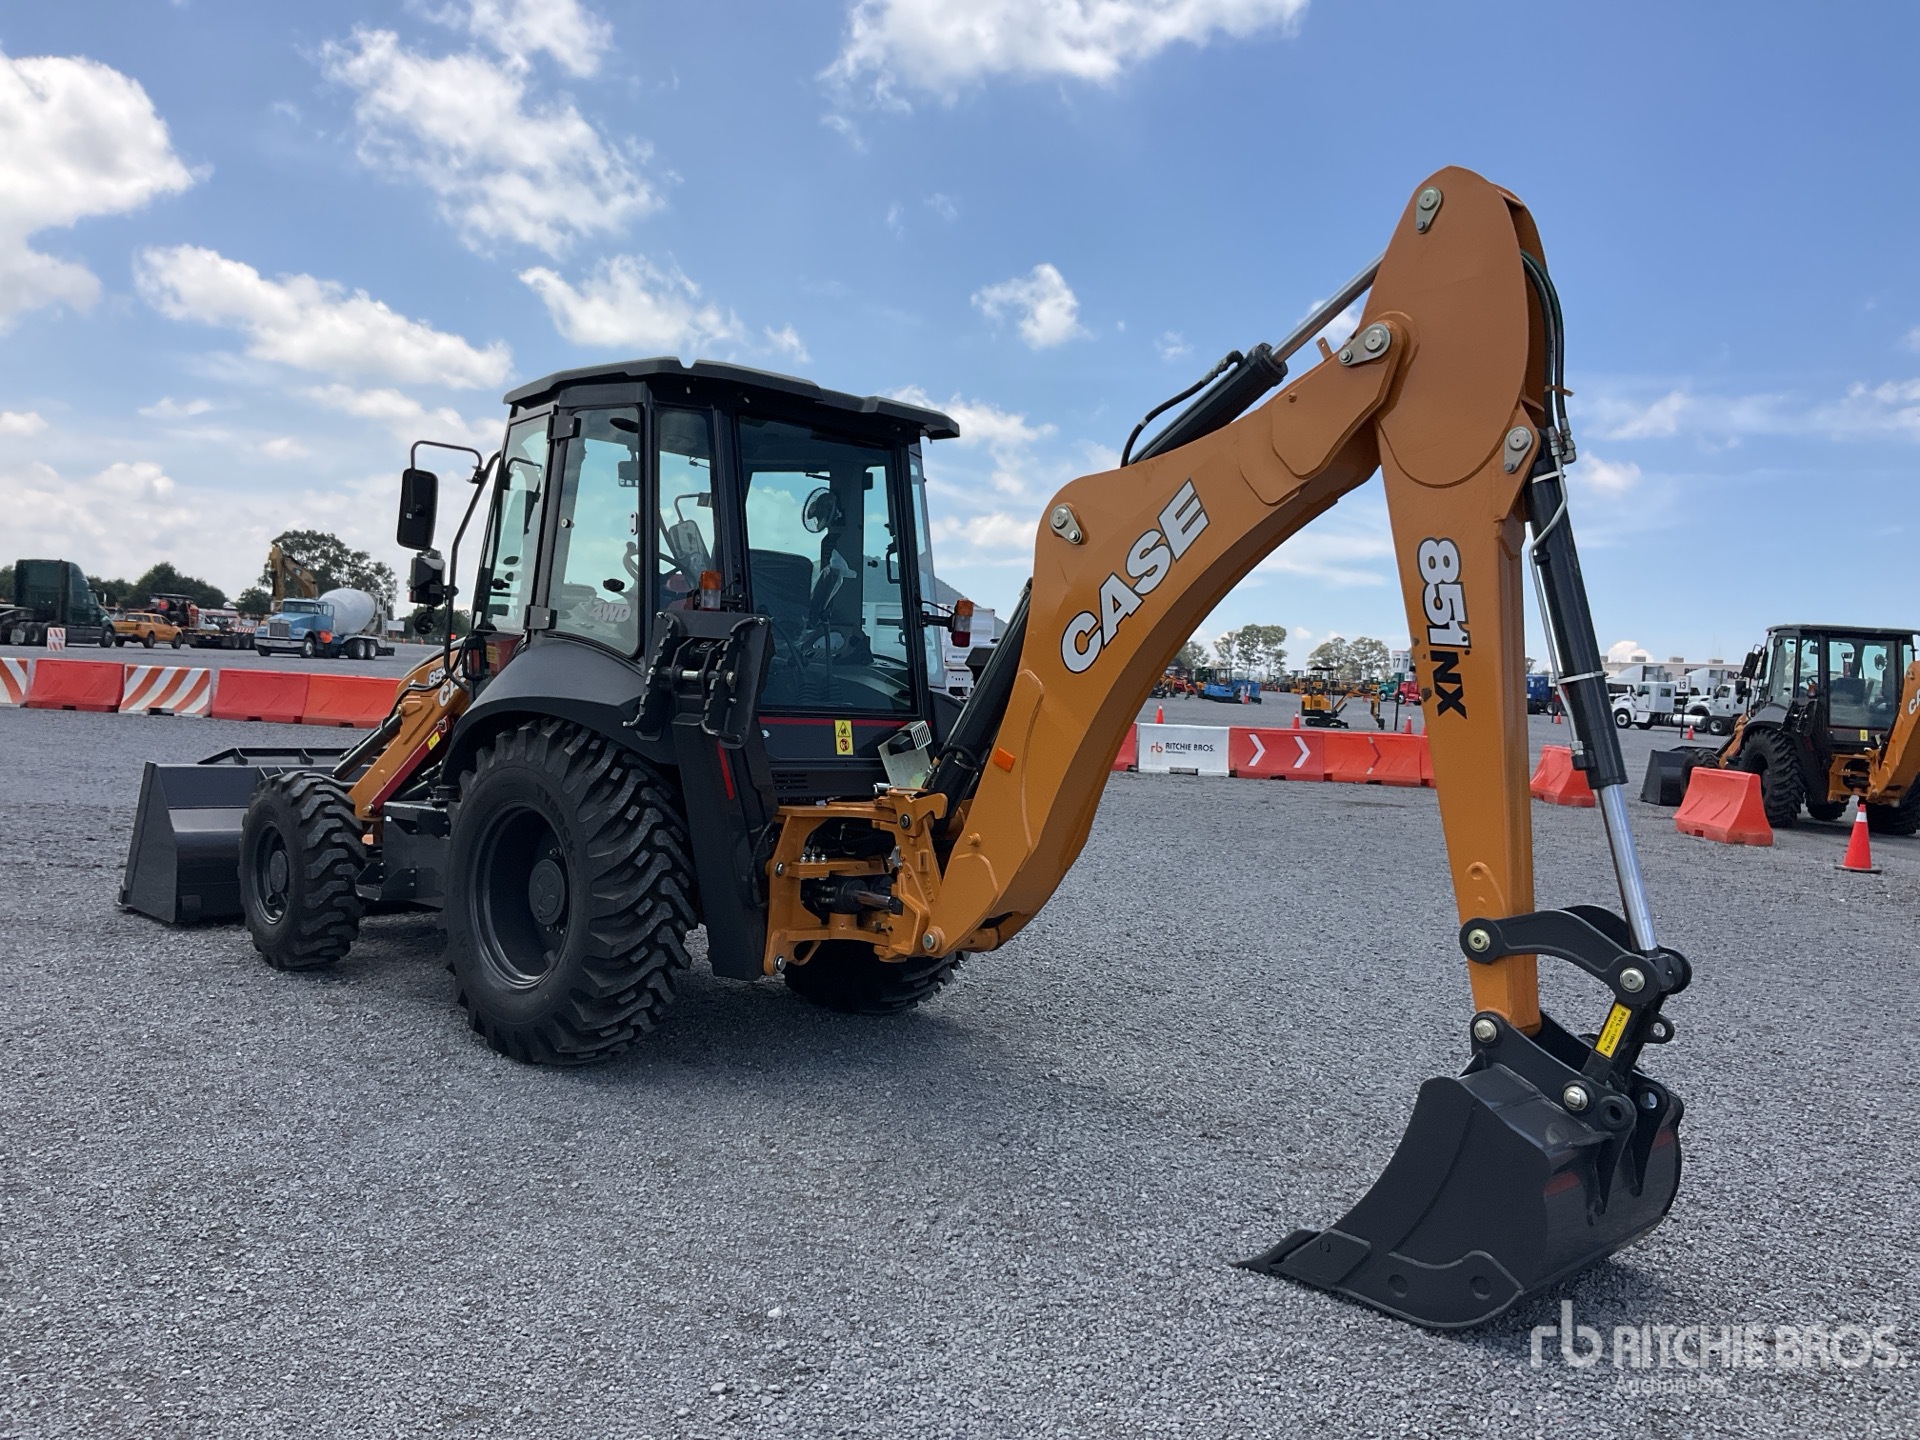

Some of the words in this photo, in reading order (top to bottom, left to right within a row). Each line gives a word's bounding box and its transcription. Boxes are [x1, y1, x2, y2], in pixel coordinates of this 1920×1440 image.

[1061, 477, 1210, 674] CASE
[589, 603, 632, 623] 4WD
[1679, 681, 1687, 690] 13
[1165, 742, 1191, 751] RITCHIE
